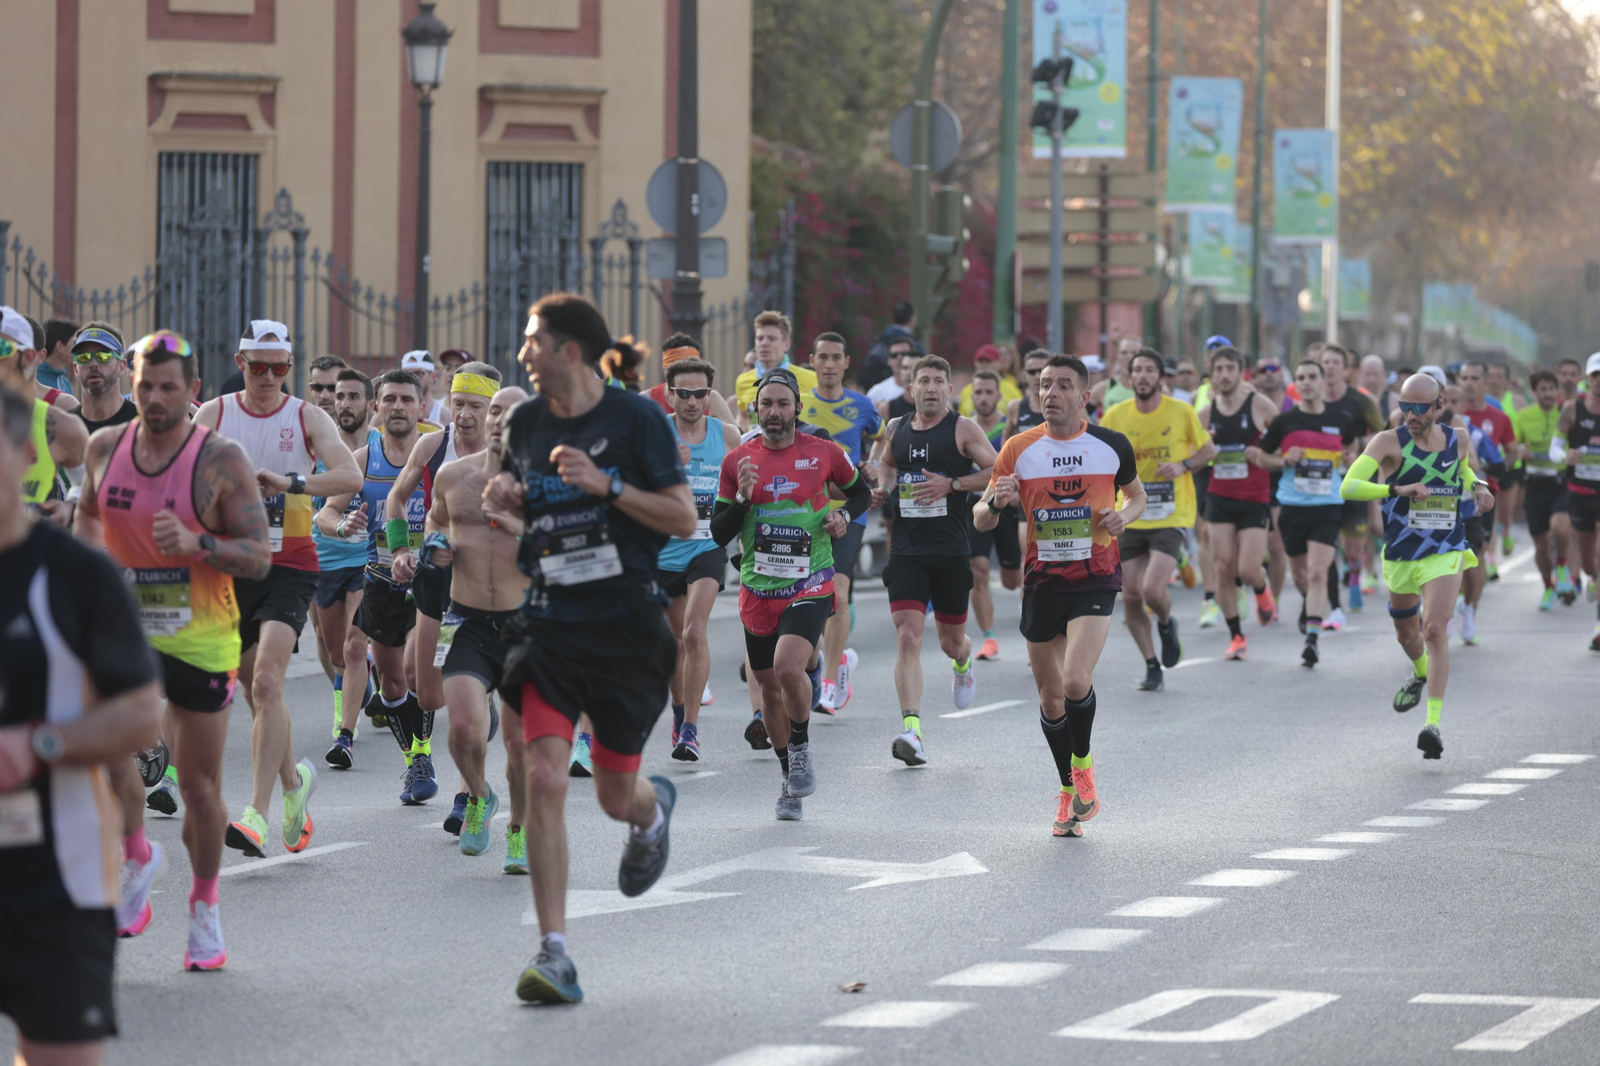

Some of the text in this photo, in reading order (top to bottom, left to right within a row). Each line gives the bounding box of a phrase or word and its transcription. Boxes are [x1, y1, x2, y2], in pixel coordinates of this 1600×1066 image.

[279, 441, 294, 450] OTSO
[1053, 455, 1083, 468] RUN
[1059, 466, 1076, 475] FOR
[1053, 478, 1082, 492] FUN
[556, 509, 599, 527] ZURICH
[1050, 509, 1084, 519] ZURICH
[772, 527, 805, 537] ZURICH
[1053, 526, 1073, 537] 1583
[771, 543, 792, 553] 2895
[1053, 539, 1074, 549] YAÑEZ
[767, 556, 795, 565] GERMAN
[138, 568, 182, 582] ZURICH
[774, 584, 797, 597] MAX
